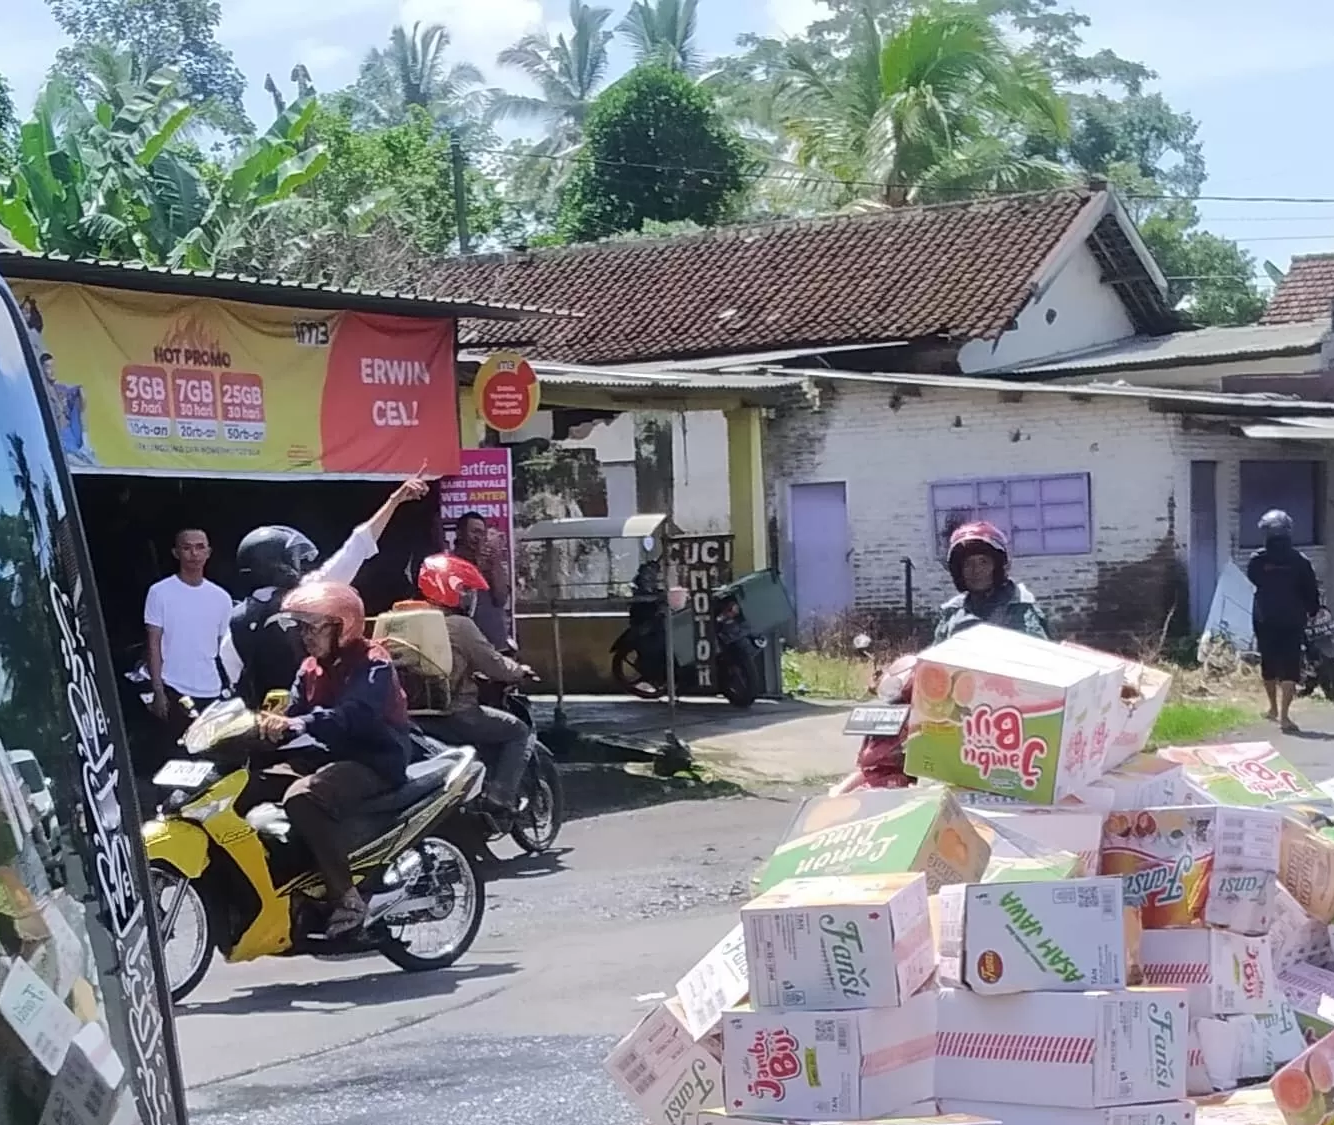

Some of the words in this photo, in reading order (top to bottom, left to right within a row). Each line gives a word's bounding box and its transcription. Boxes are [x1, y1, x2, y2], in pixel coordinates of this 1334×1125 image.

[154, 347, 181, 364] HOT
[185, 349, 231, 367] PROMO
[361, 357, 430, 385] ERWIN
[125, 375, 166, 400] 3GB
[176, 379, 214, 403] 7GB
[222, 385, 262, 405] 25GB
[132, 401, 139, 413] 5
[141, 401, 162, 414] hari
[180, 404, 192, 416] 30
[194, 405, 214, 417] hari
[227, 406, 239, 418] 30
[241, 407, 261, 419] hari
[461, 460, 506, 476] artfren
[998, 890, 1043, 938] JAWA
[1036, 938, 1085, 984] ASAM
